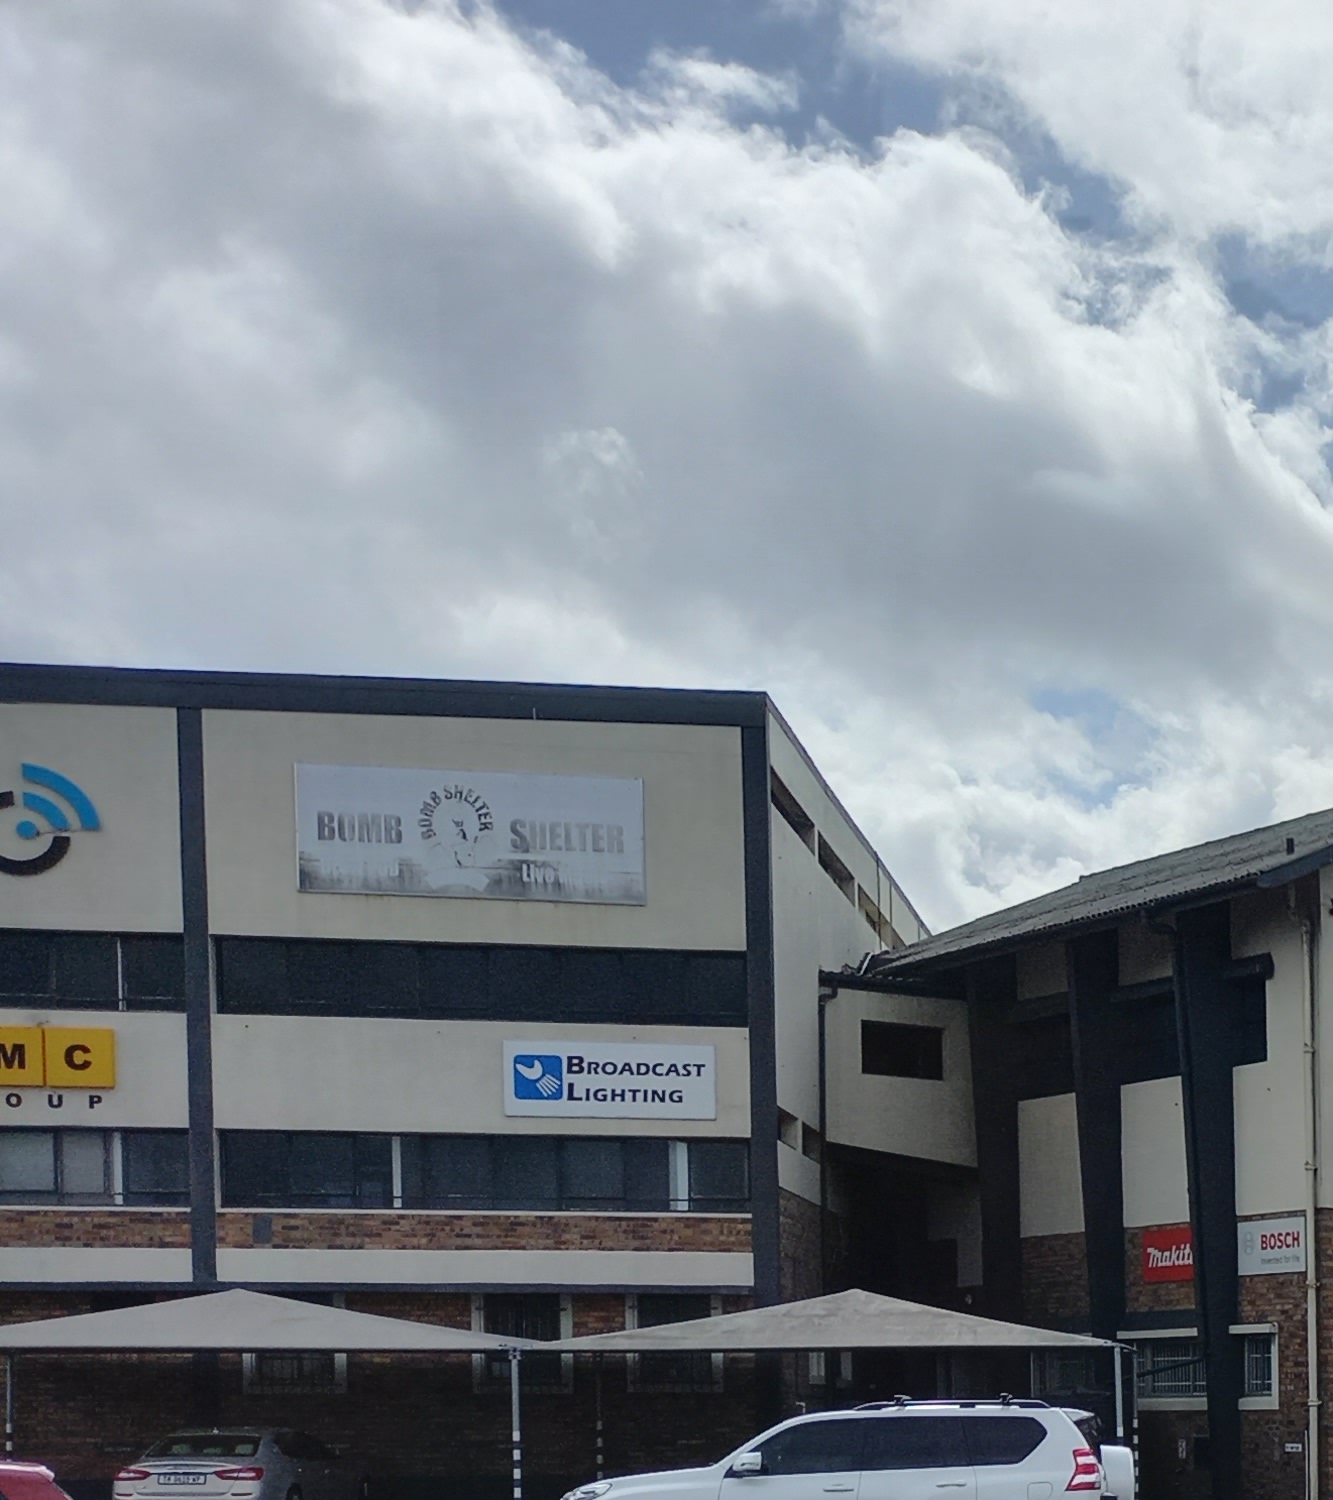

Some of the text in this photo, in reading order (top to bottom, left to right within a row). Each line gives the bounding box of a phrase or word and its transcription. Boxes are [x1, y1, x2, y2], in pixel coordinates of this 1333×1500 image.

[317, 810, 625, 854] BOMB SHELTER
[0, 1043, 93, 1070] MC
[5, 1092, 103, 1109] OUP
[1260, 1231, 1300, 1251] BOSCH
